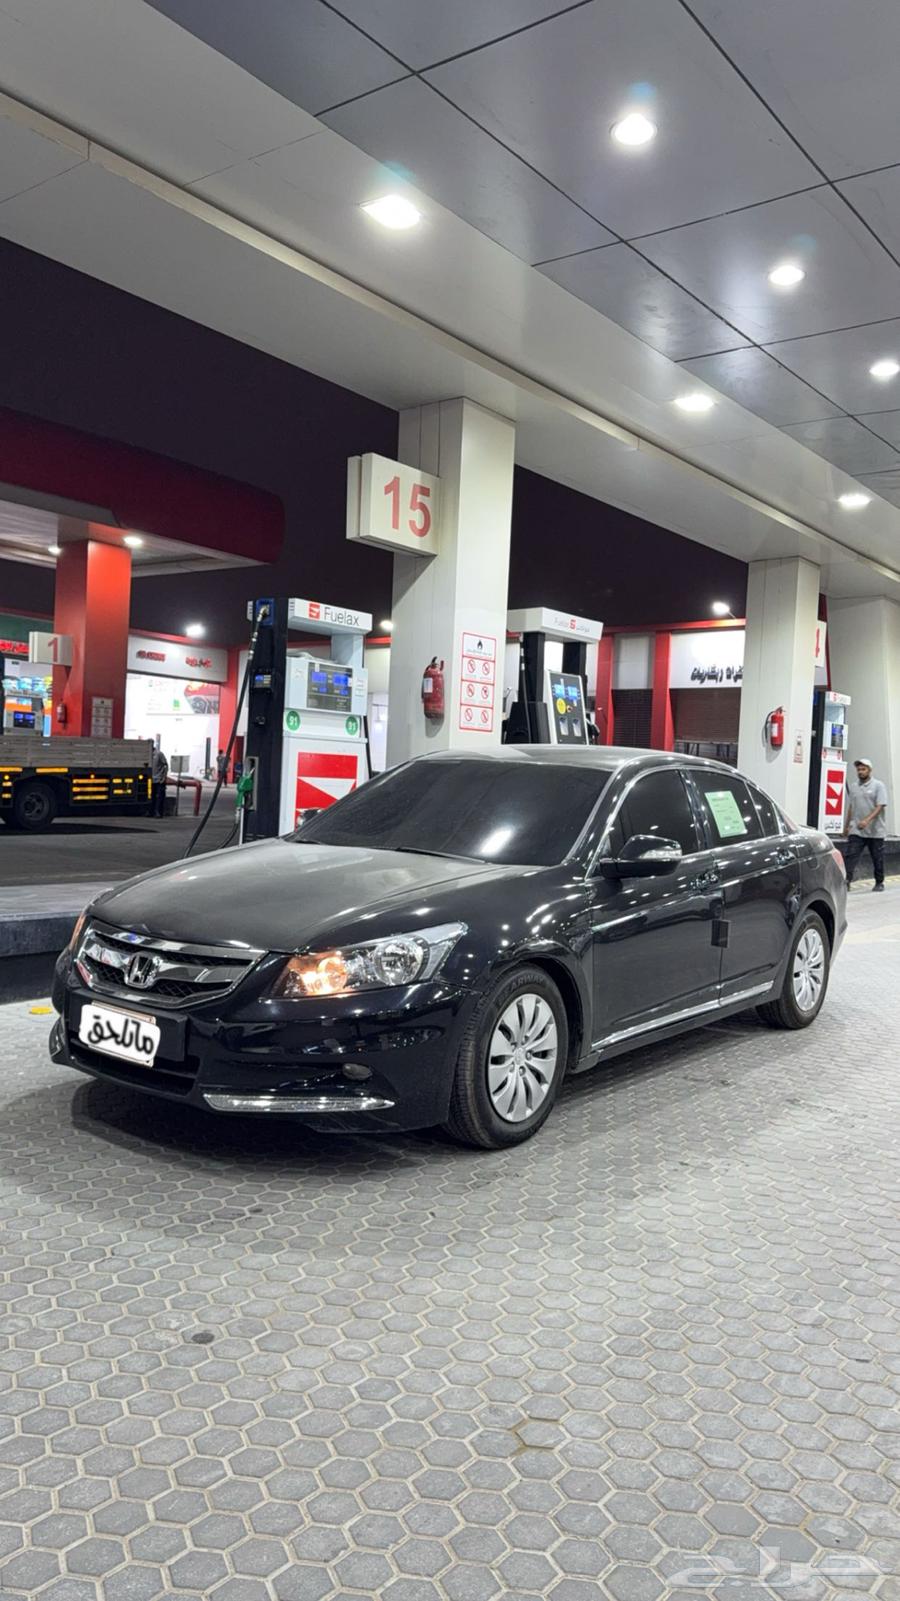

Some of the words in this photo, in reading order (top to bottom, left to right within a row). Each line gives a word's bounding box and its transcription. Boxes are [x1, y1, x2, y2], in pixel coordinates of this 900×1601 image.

[383, 475, 431, 538] 15
[324, 606, 360, 626] Fuelax
[48, 637, 58, 663] 1
